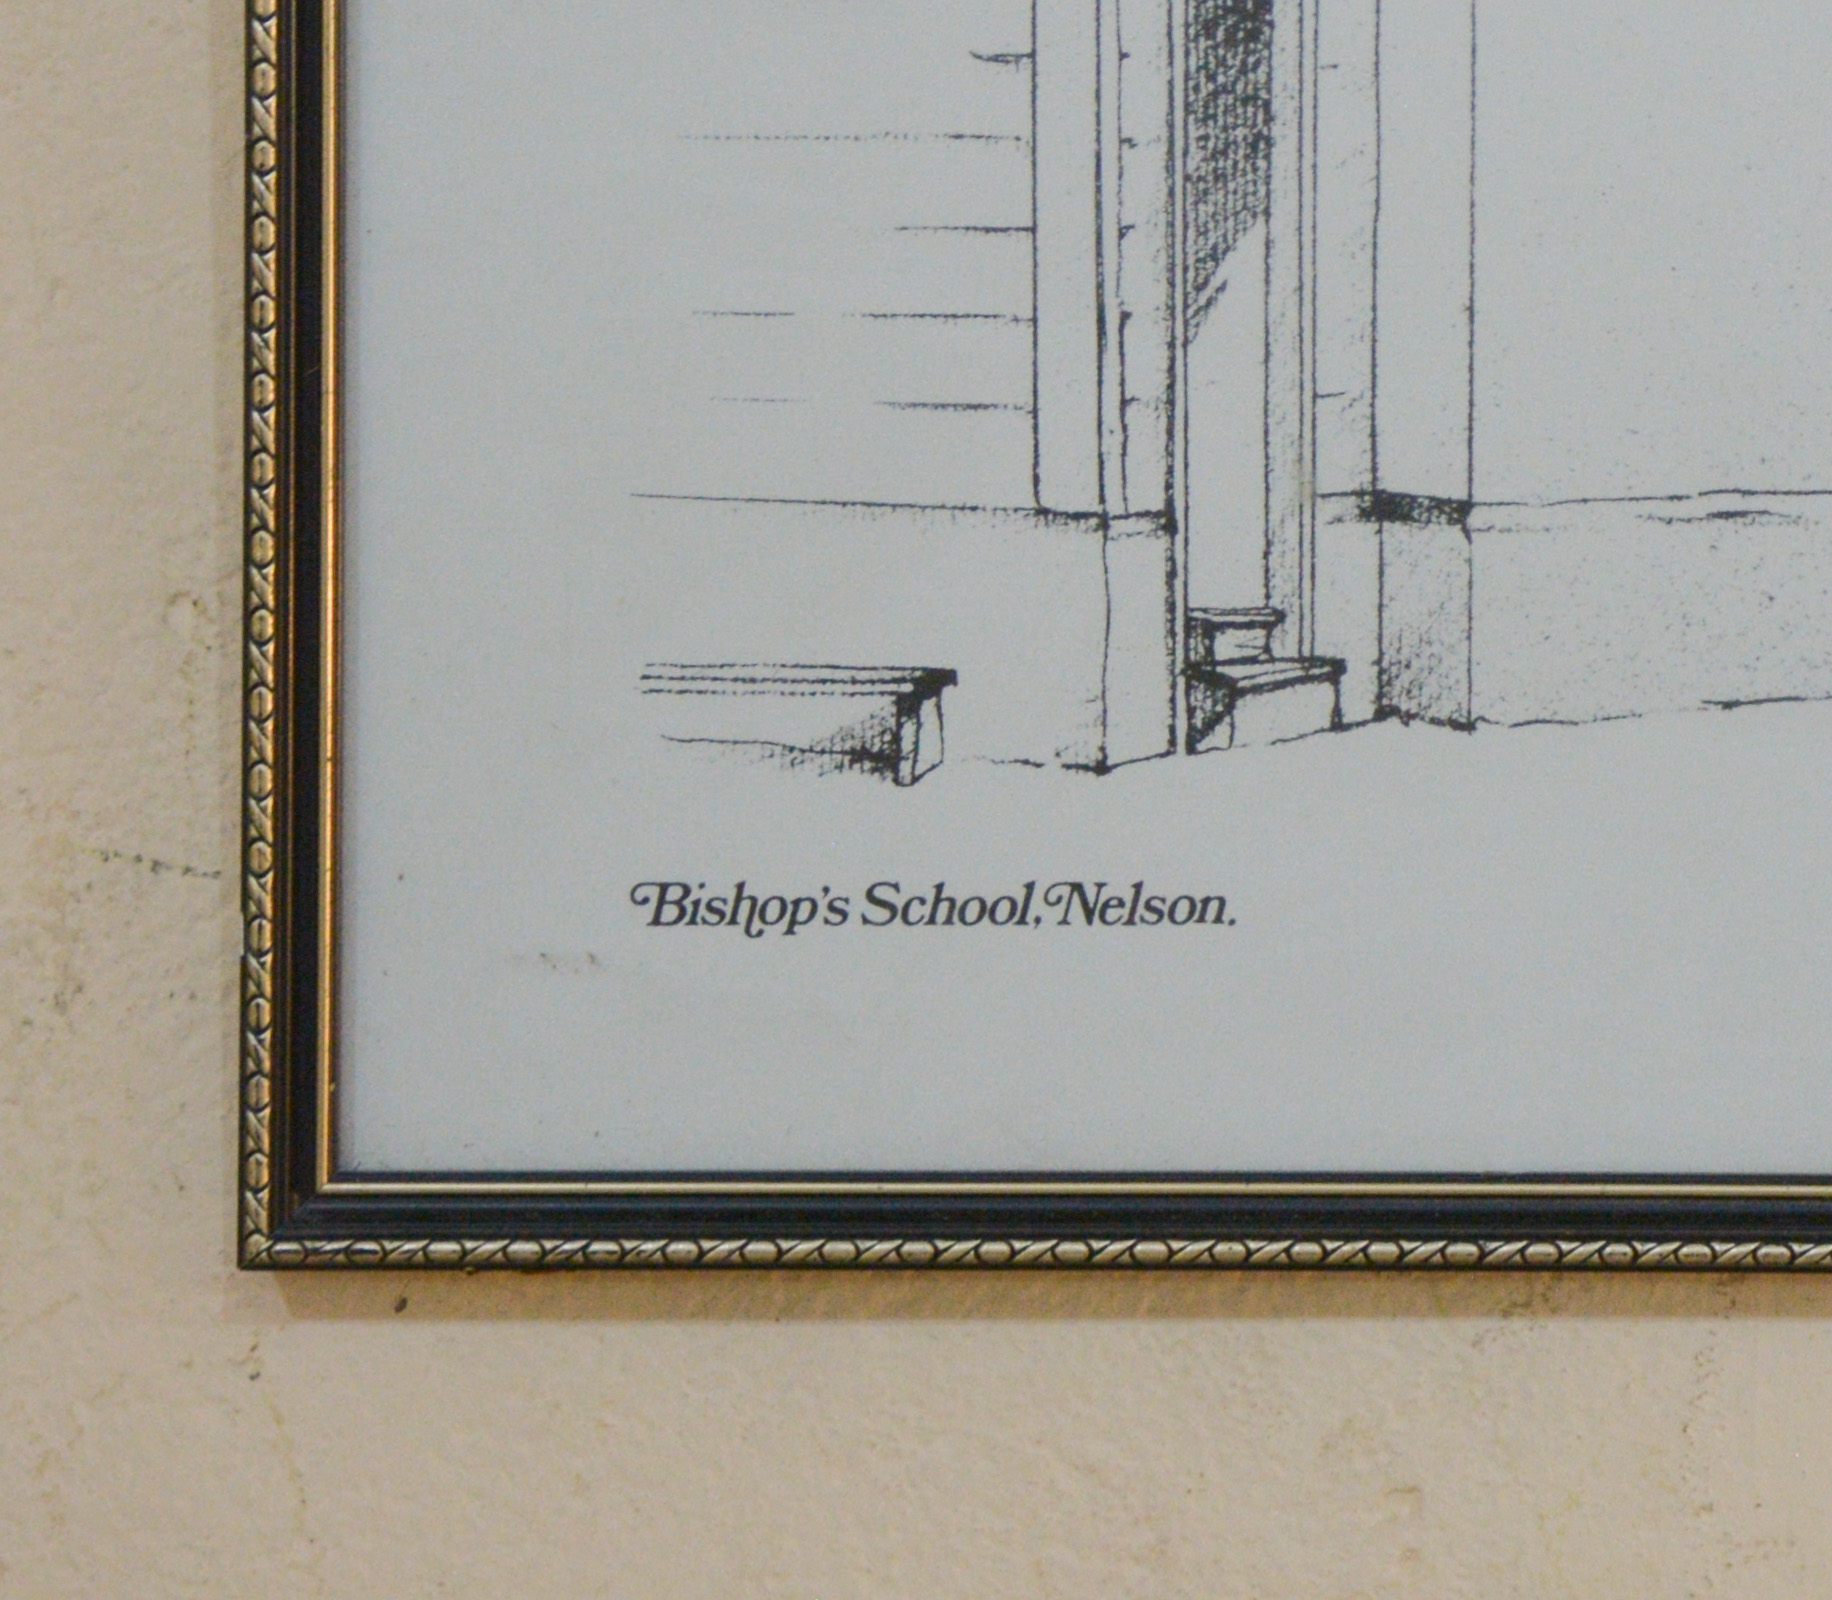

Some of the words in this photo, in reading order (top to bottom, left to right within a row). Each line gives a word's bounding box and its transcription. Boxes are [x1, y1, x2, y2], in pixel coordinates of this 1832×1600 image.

[630, 880, 849, 938] Bishop's
[861, 880, 1043, 930] School,
[1043, 881, 1237, 927] Nelson.
